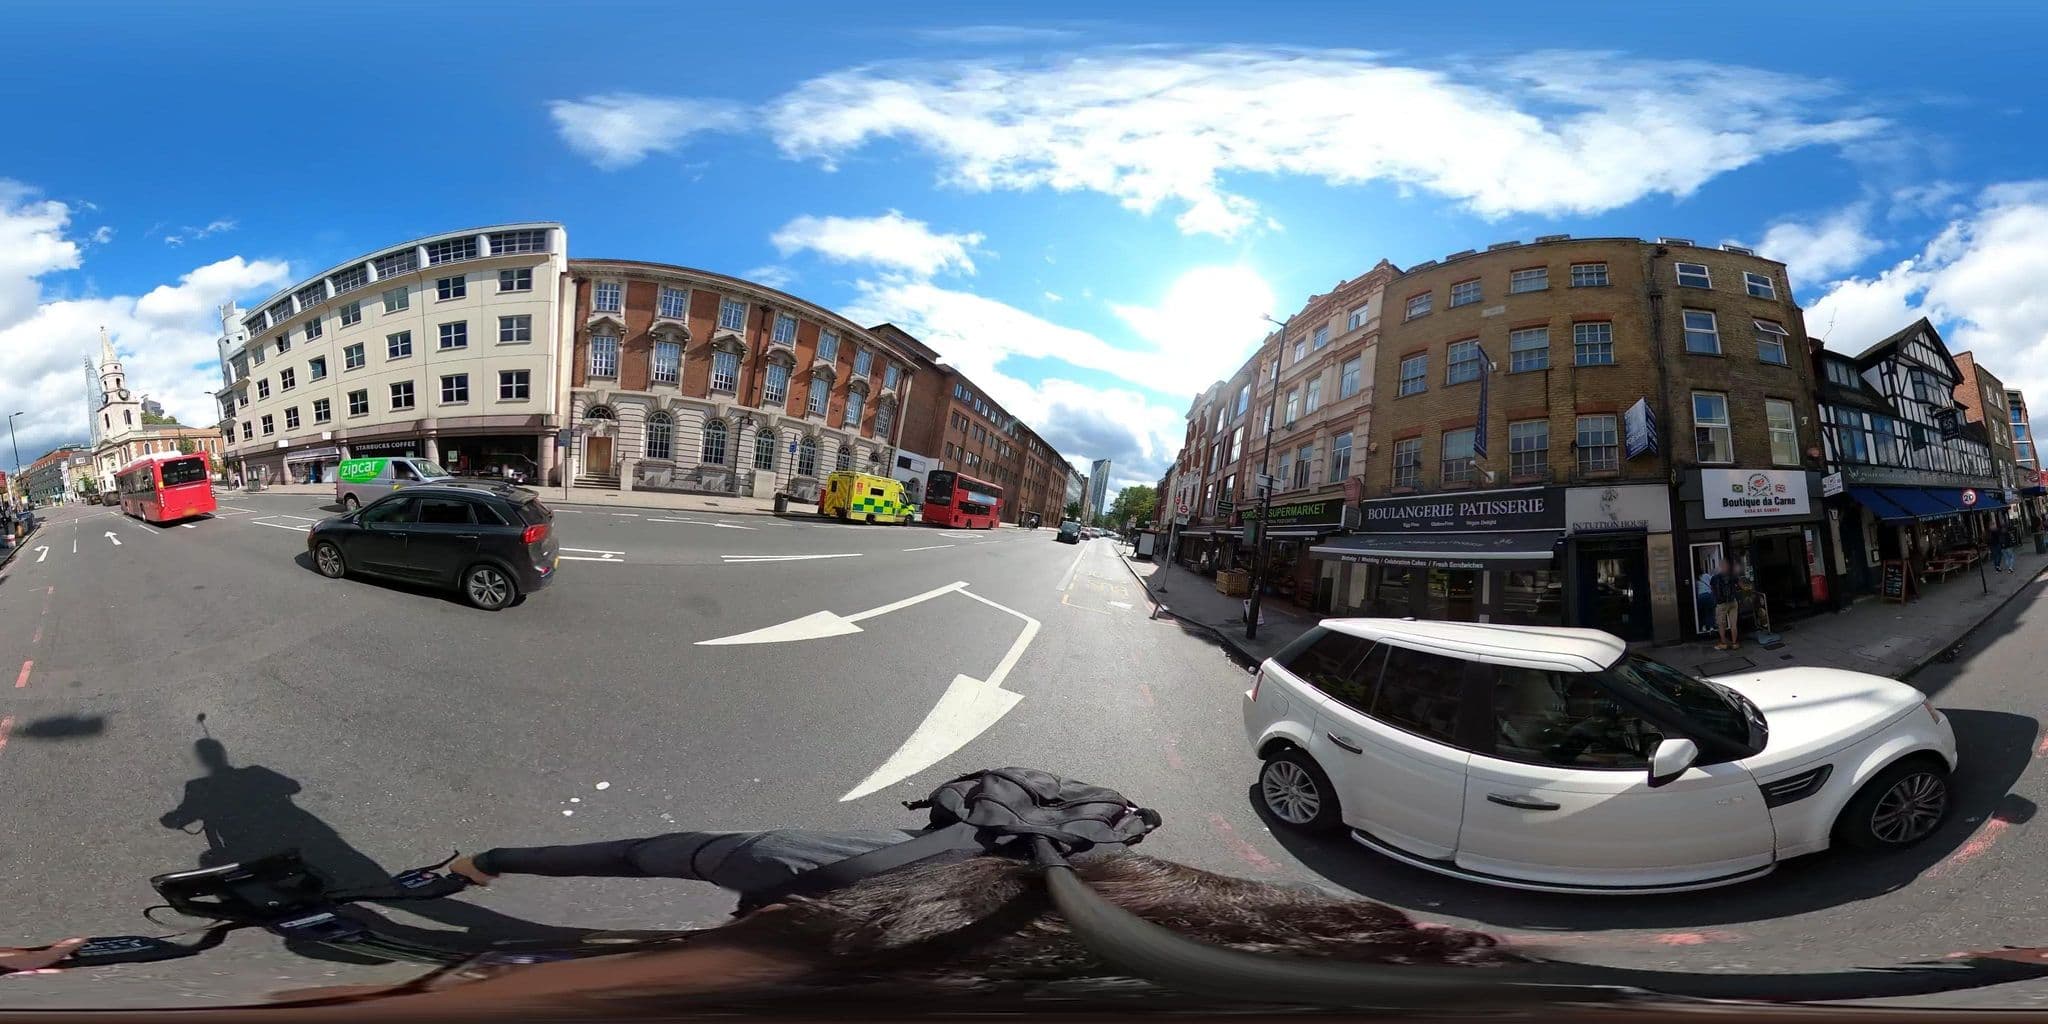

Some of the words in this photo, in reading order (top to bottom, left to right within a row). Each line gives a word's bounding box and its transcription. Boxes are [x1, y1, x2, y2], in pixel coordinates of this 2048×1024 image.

[342, 461, 378, 479] zipcar
[1368, 504, 1454, 520] BOULANGERIE
[1459, 498, 1545, 516] PATISSERIE
[1722, 497, 1761, 508] Boutique
[1763, 496, 1773, 506] da
[1774, 496, 1796, 505] Carne
[1268, 503, 1327, 518] SUPERMARKET
